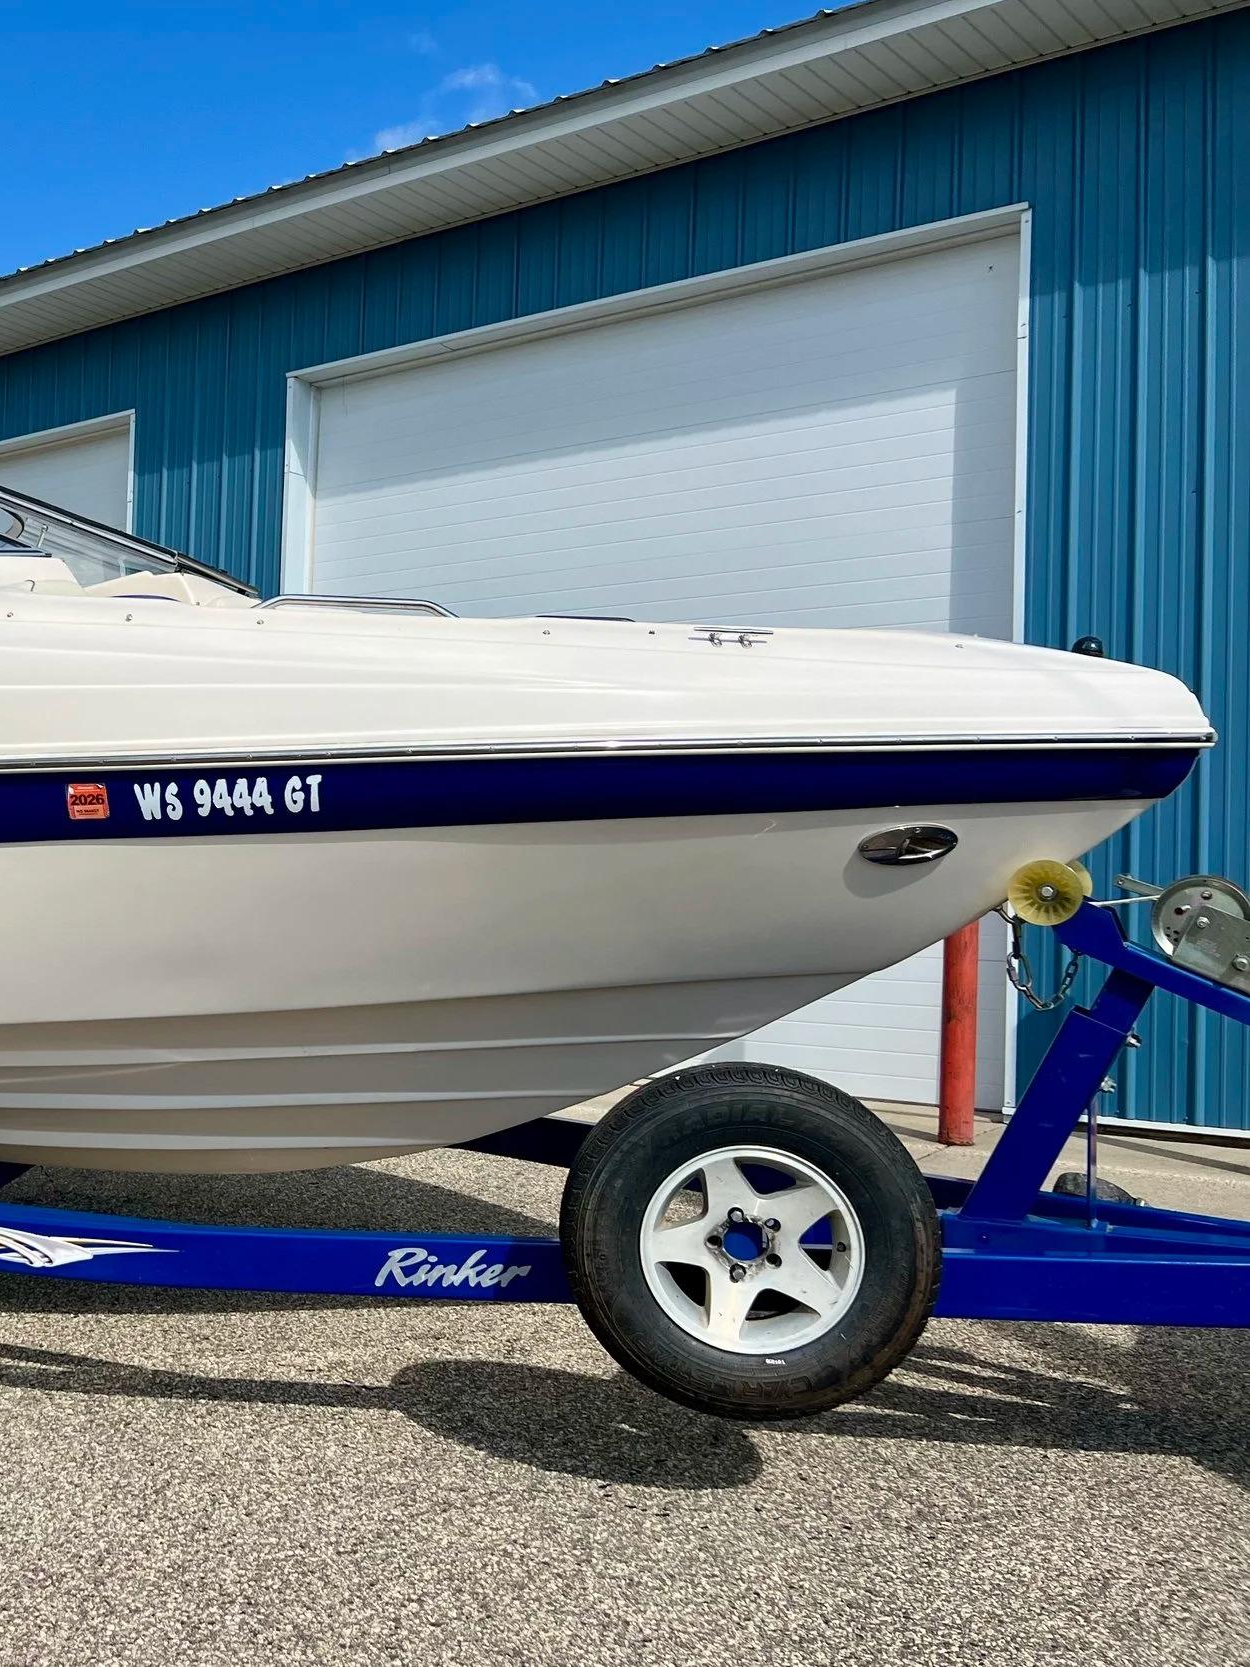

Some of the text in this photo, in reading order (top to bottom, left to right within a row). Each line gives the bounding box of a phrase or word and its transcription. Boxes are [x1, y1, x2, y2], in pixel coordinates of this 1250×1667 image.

[70, 794, 104, 806] 2026
[134, 775, 322, 820] WS 9444 GT
[374, 1248, 532, 1287] Rinker
